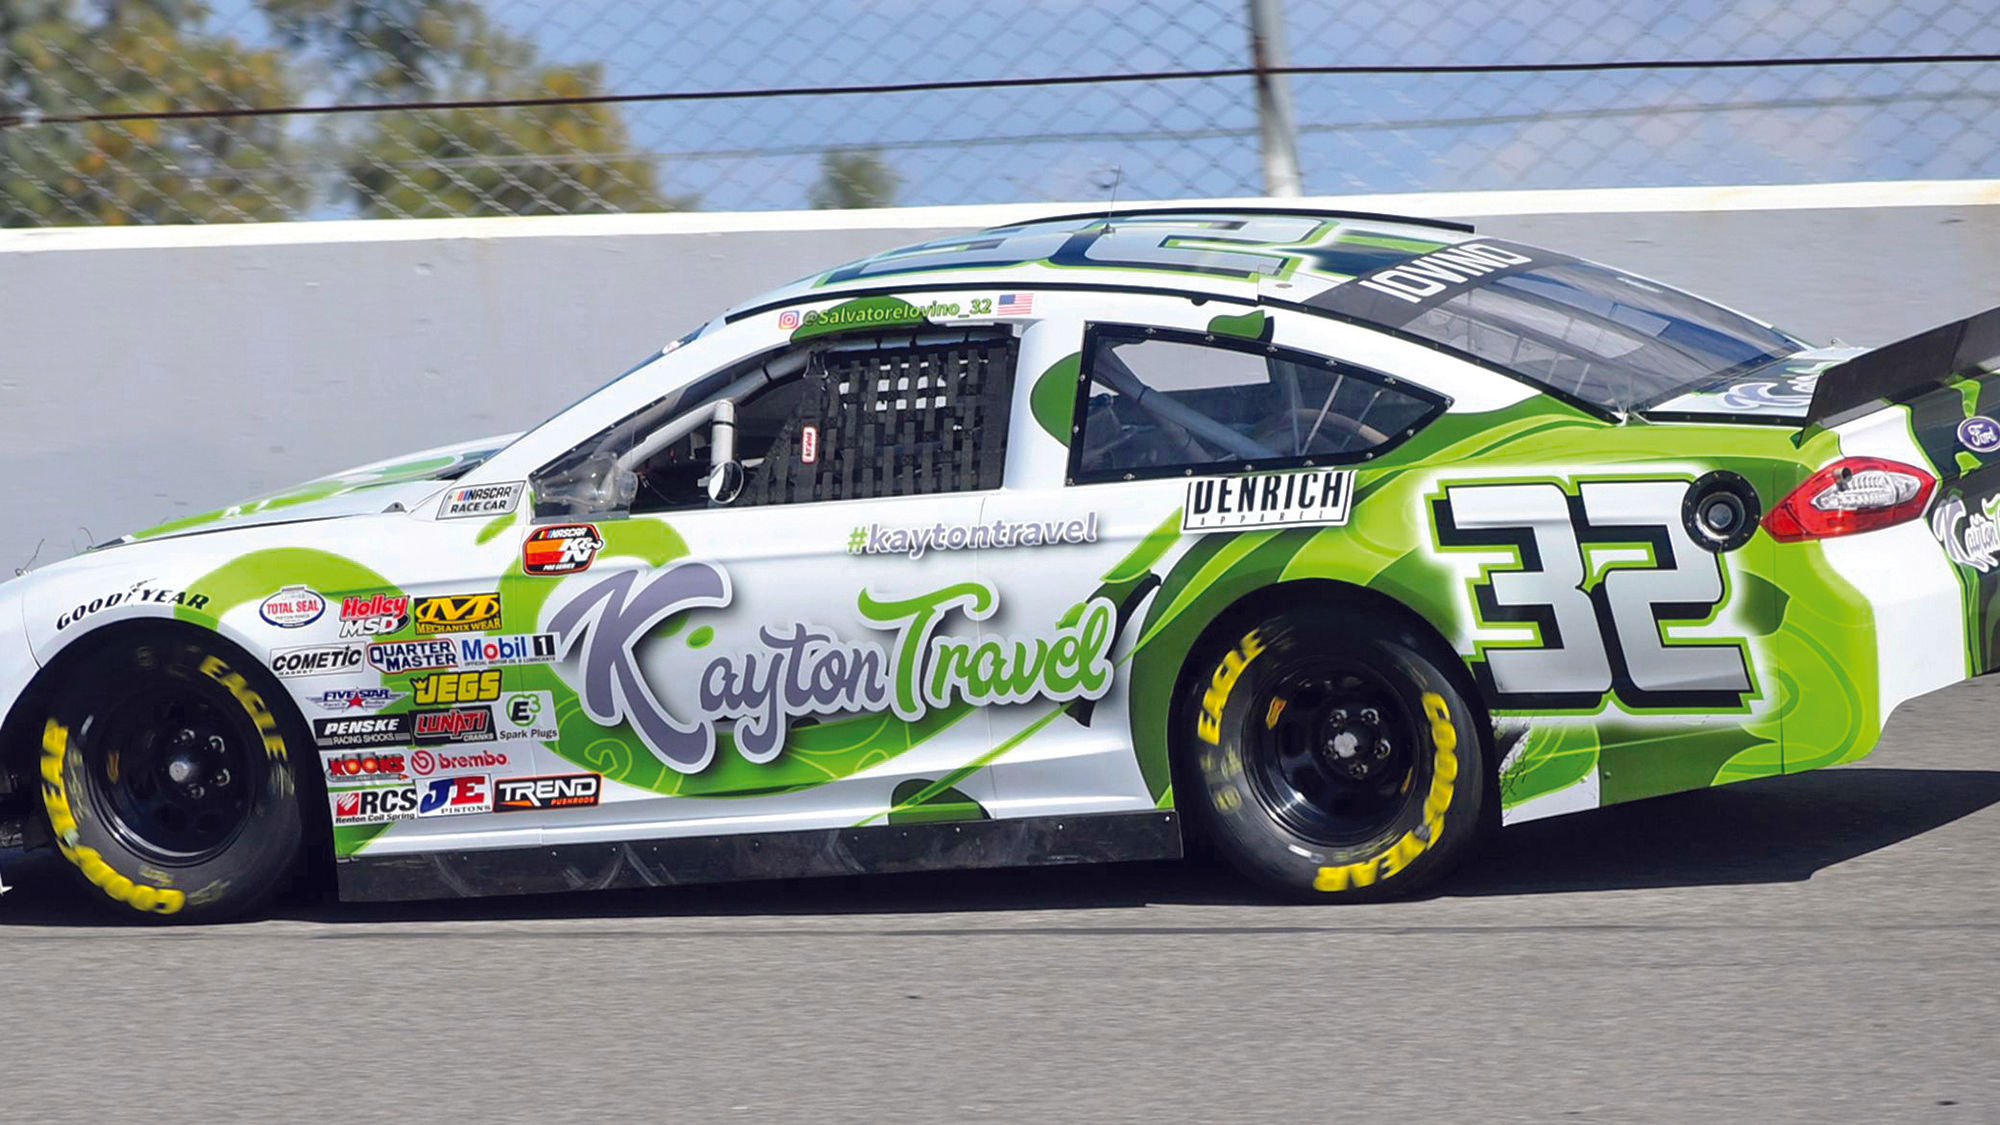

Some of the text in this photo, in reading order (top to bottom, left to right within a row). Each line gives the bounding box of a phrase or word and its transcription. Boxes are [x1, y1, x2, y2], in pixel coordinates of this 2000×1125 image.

[1358, 243, 1532, 304] IOVINO
[1967, 422, 1998, 447] Ford
[464, 486, 512, 502] NASCAR
[450, 499, 508, 514] RACE CAR
[549, 527, 588, 539] NASCAR
[848, 512, 1097, 558] #kaytontravel
[1432, 480, 1754, 707] 32
[266, 599, 319, 615] TOTAL SEAL
[341, 594, 409, 620] Holley
[339, 617, 399, 638] MSD
[416, 617, 501, 634] MECHANIX WEAR
[272, 645, 362, 672] COMETIC
[370, 641, 451, 664] QUARTER
[461, 636, 527, 661] Mobil
[386, 653, 457, 671] MASTER
[548, 563, 1115, 769] Kayton Travel
[324, 688, 390, 701] FIVE STAR
[414, 671, 502, 704] JEGS
[324, 718, 400, 736] PENSKE
[417, 709, 486, 737] LUNATI
[333, 732, 394, 745] RACING SHOCKS
[463, 732, 495, 742] CRANKS
[499, 728, 558, 741] Spark Plugs
[327, 754, 405, 776] KOOKS
[438, 750, 508, 769] brembo
[360, 788, 418, 815] RCS
[420, 775, 486, 814] JE
[499, 777, 597, 807] TREND
[550, 796, 595, 806] PUSHRODS
[336, 812, 415, 824] Renton Coil Spring
[441, 804, 492, 815] PISTONS
